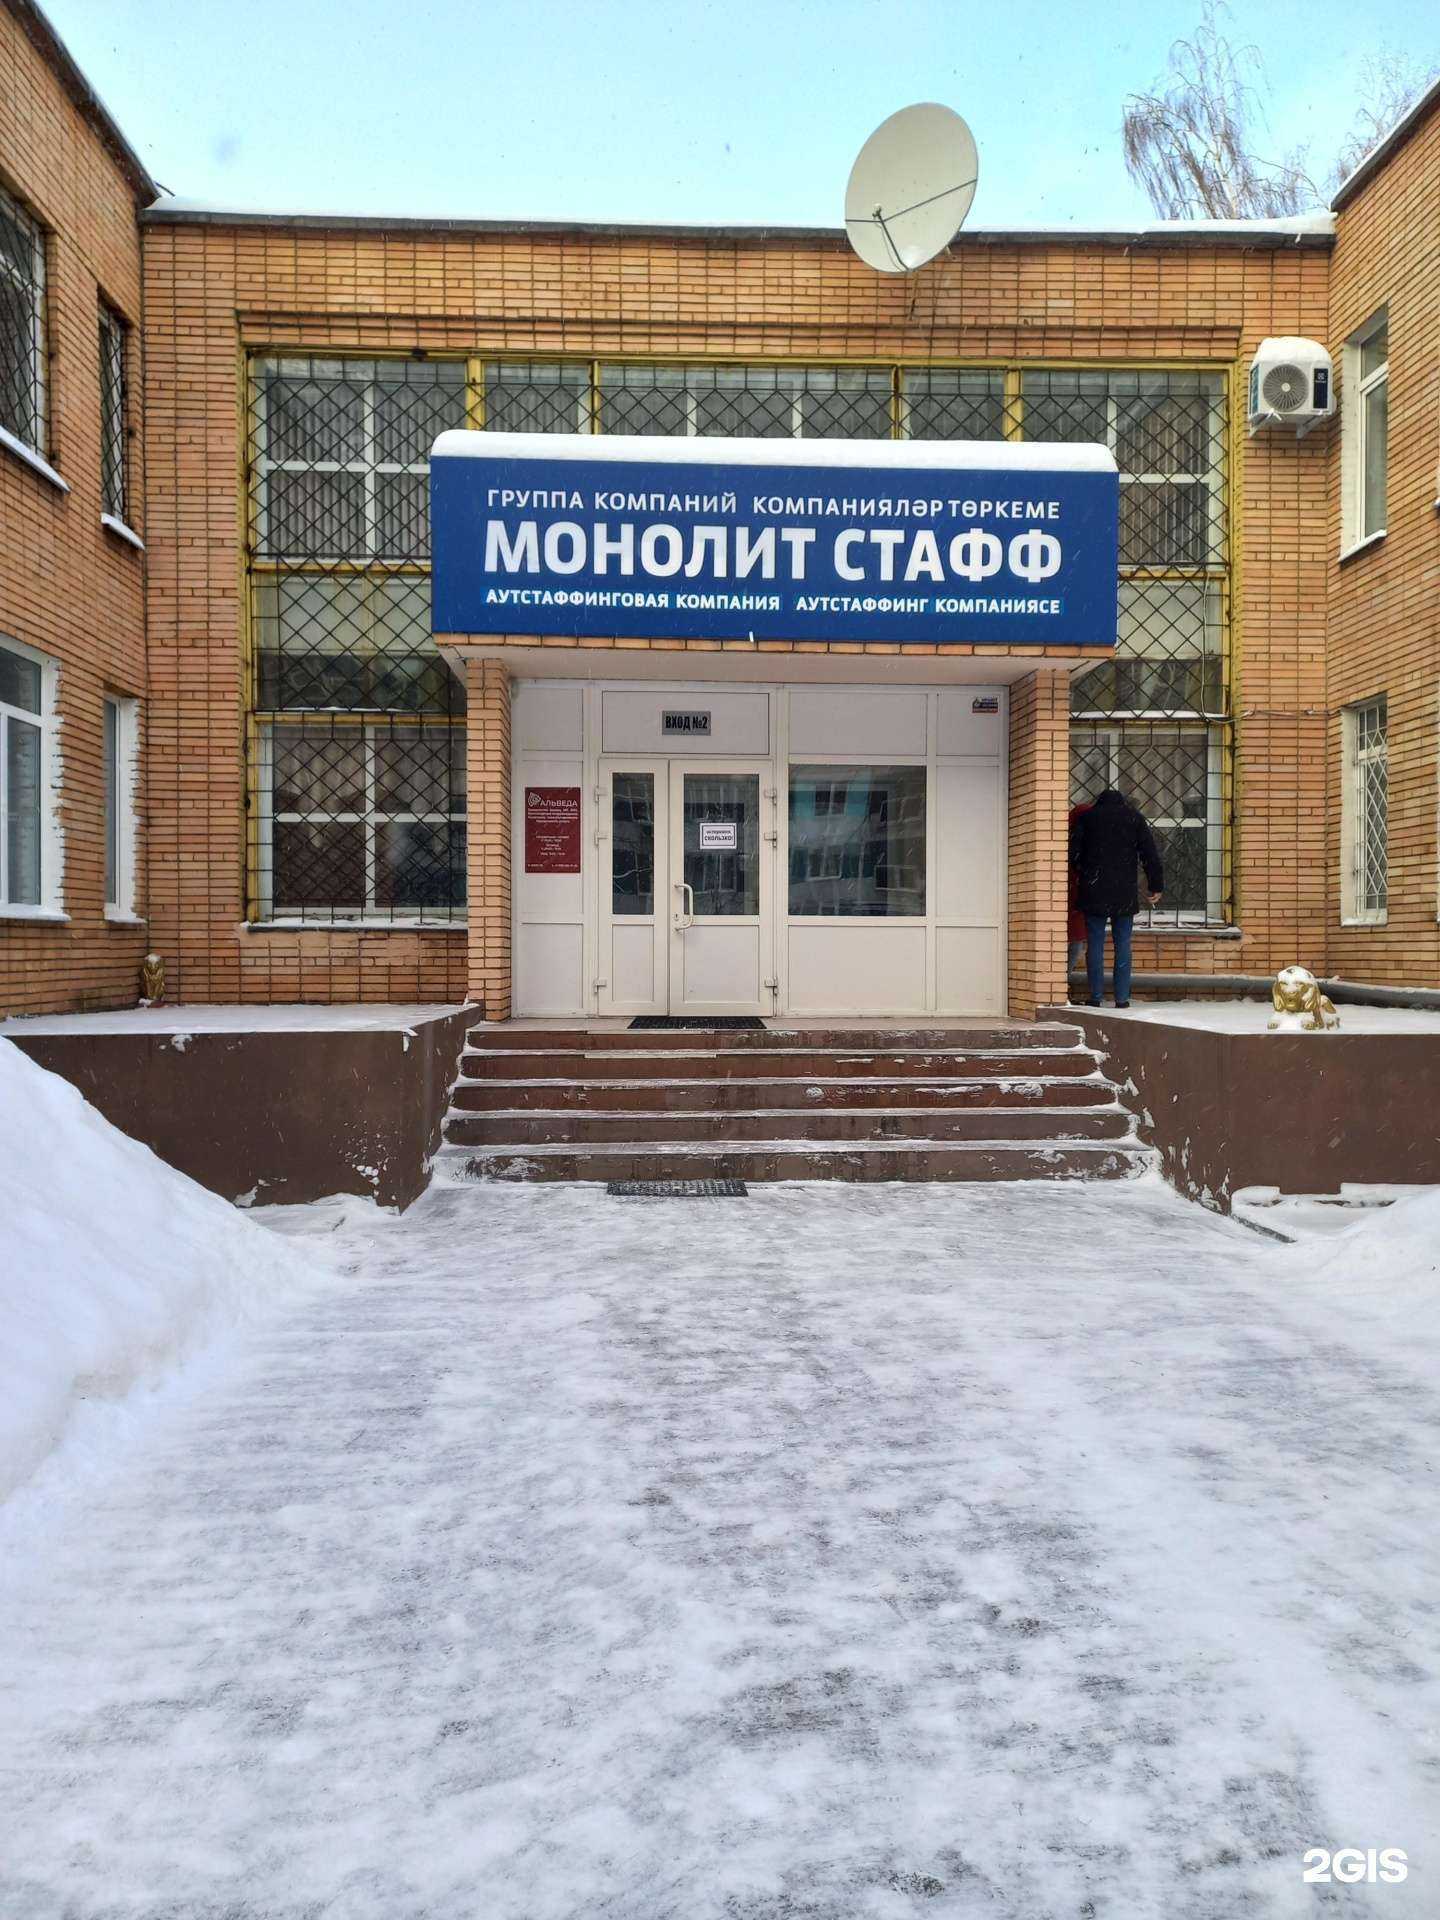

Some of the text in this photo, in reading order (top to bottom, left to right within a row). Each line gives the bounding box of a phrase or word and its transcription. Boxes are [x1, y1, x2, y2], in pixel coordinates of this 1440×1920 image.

[487, 488, 737, 514] ГРУППА КОМПАНИЙ
[753, 495, 1061, 520] КОМПАНИЯЛӘР ТӨРКЕМЕ
[484, 519, 1062, 583] МОНОЛИТ СТАФФ
[486, 588, 780, 611] АУТСТАФФИНГОВАЯ КОМПАНИЯ
[796, 596, 1061, 616] АУТСТАФФИНГ КОМПАНИЯСЕ
[665, 716, 708, 731] ВХОД №2
